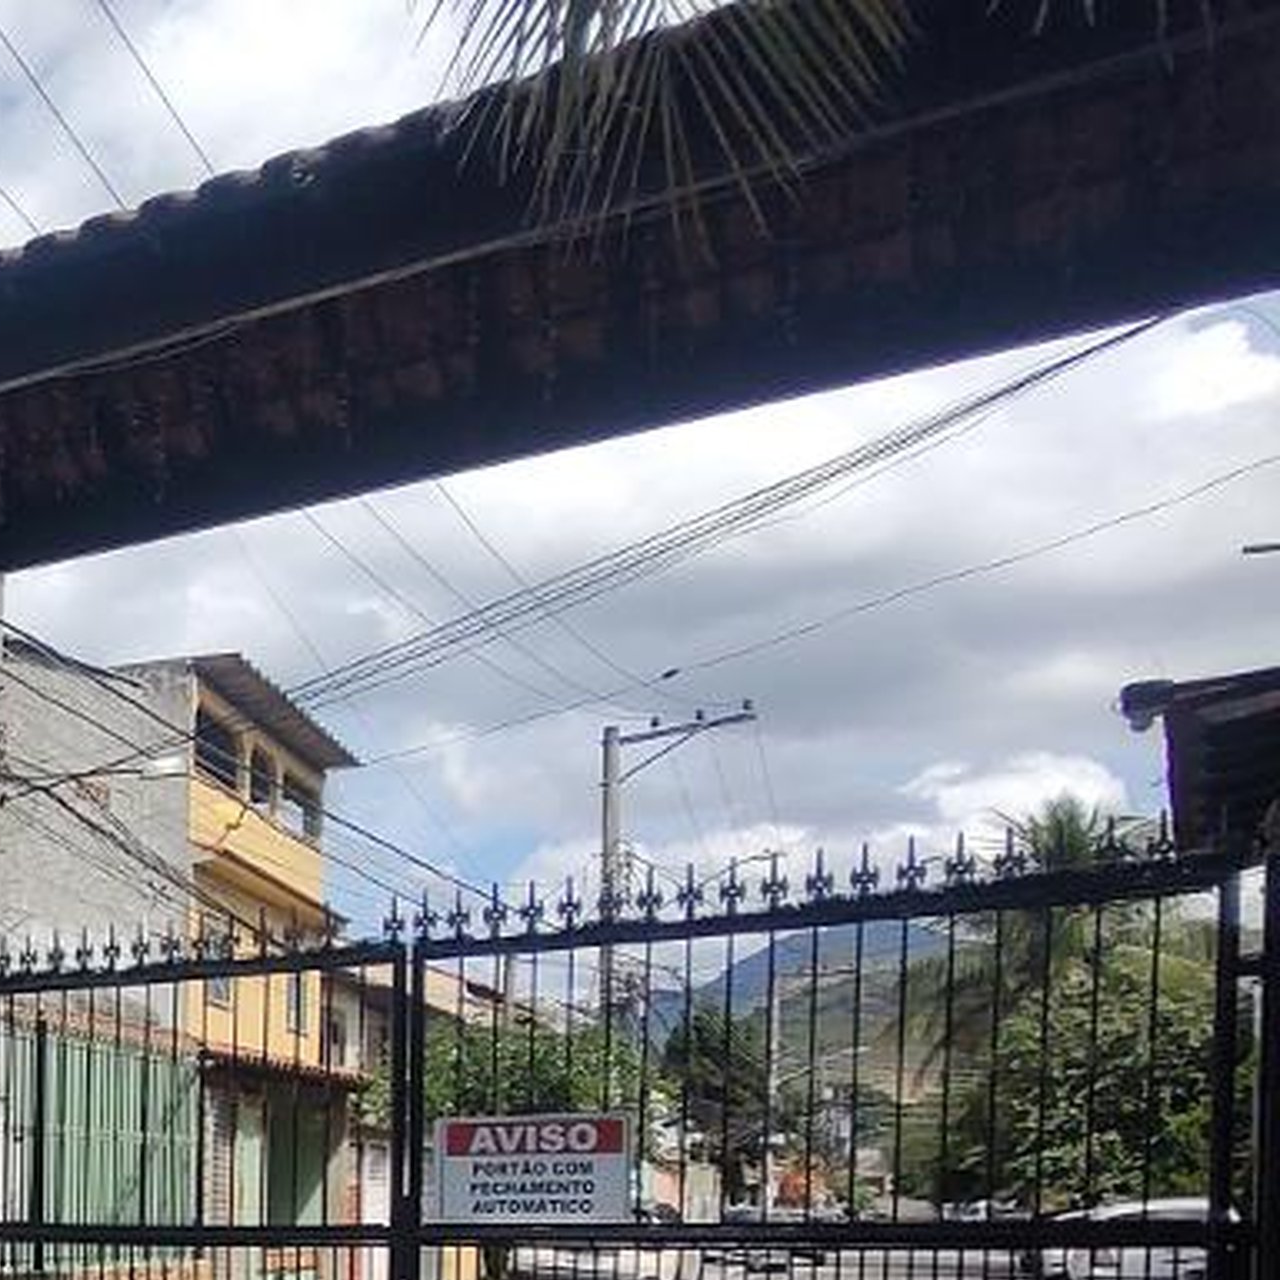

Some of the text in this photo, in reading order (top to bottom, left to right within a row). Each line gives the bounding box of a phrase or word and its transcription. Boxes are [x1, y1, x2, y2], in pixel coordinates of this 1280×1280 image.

[469, 1123, 598, 1153] AVISO
[472, 1160, 594, 1177] PORTÃO COM
[469, 1179, 595, 1196] FECHAMENTO
[471, 1197, 594, 1215] AUTOMÁTICO
